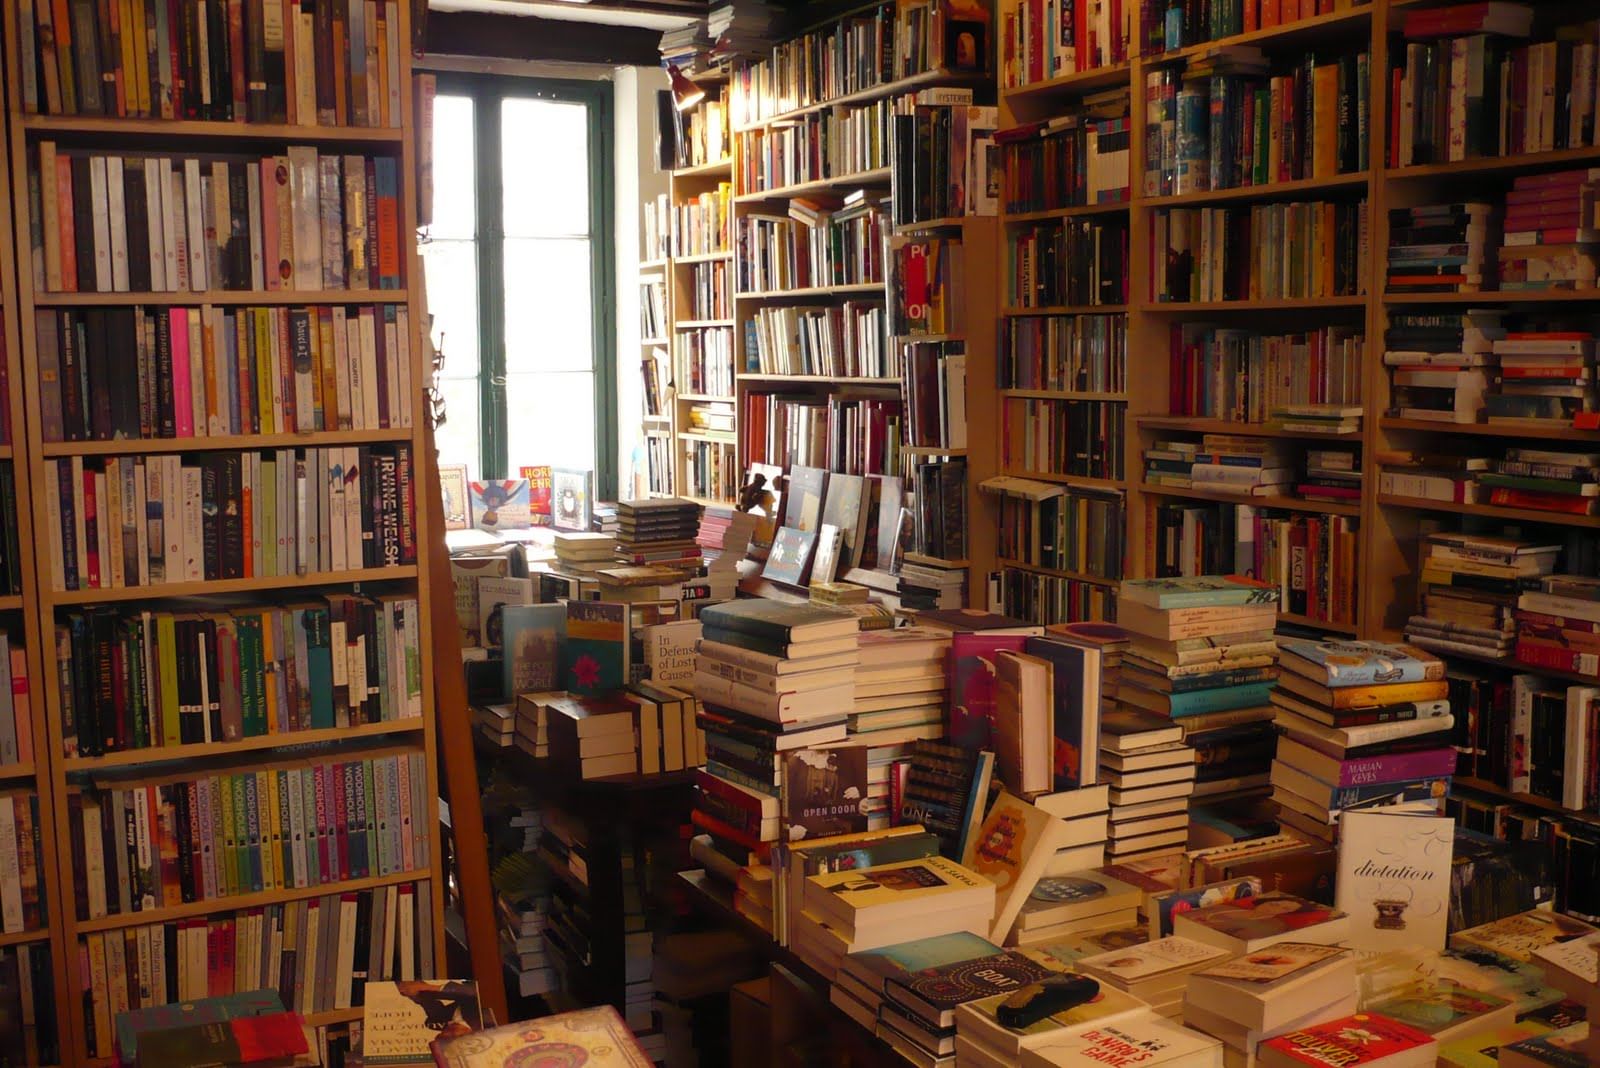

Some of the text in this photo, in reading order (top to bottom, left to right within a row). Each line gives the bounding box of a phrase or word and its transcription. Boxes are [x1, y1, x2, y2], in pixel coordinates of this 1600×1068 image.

[1340, 94, 1349, 125] SLANG
[159, 313, 170, 374] Heartsnatcher
[381, 456, 399, 568] IRVINE WELSH
[399, 448, 411, 547] THE BULLET TRICK LOUISE WELSH
[1294, 547, 1303, 589] FACTS
[659, 635, 670, 646] In
[659, 657, 691, 669] of Lost
[659, 670, 693, 681] Causes
[1347, 760, 1382, 774] MARIAN
[1351, 772, 1377, 784] KEYES
[236, 780, 246, 837] WODEHOUSE
[247, 778, 258, 836] WODEHOUSE
[280, 775, 290, 833] WODEHOUSE
[316, 770, 326, 828] WODEHOUSE
[346, 766, 356, 823] WODEHOUSE
[355, 765, 365, 822] WODEHOUSE
[188, 785, 199, 842] WODEHOUSE
[212, 781, 223, 839] WODEHOUSE
[803, 804, 856, 818] OPEN DOOR
[902, 807, 933, 824] ONE
[1353, 859, 1436, 882] dictation
[973, 969, 1019, 989] BOAT
[371, 1046, 430, 1054] ARACK
[1080, 1046, 1135, 1068] GAME
[1097, 1036, 1153, 1062] NIRO'S
